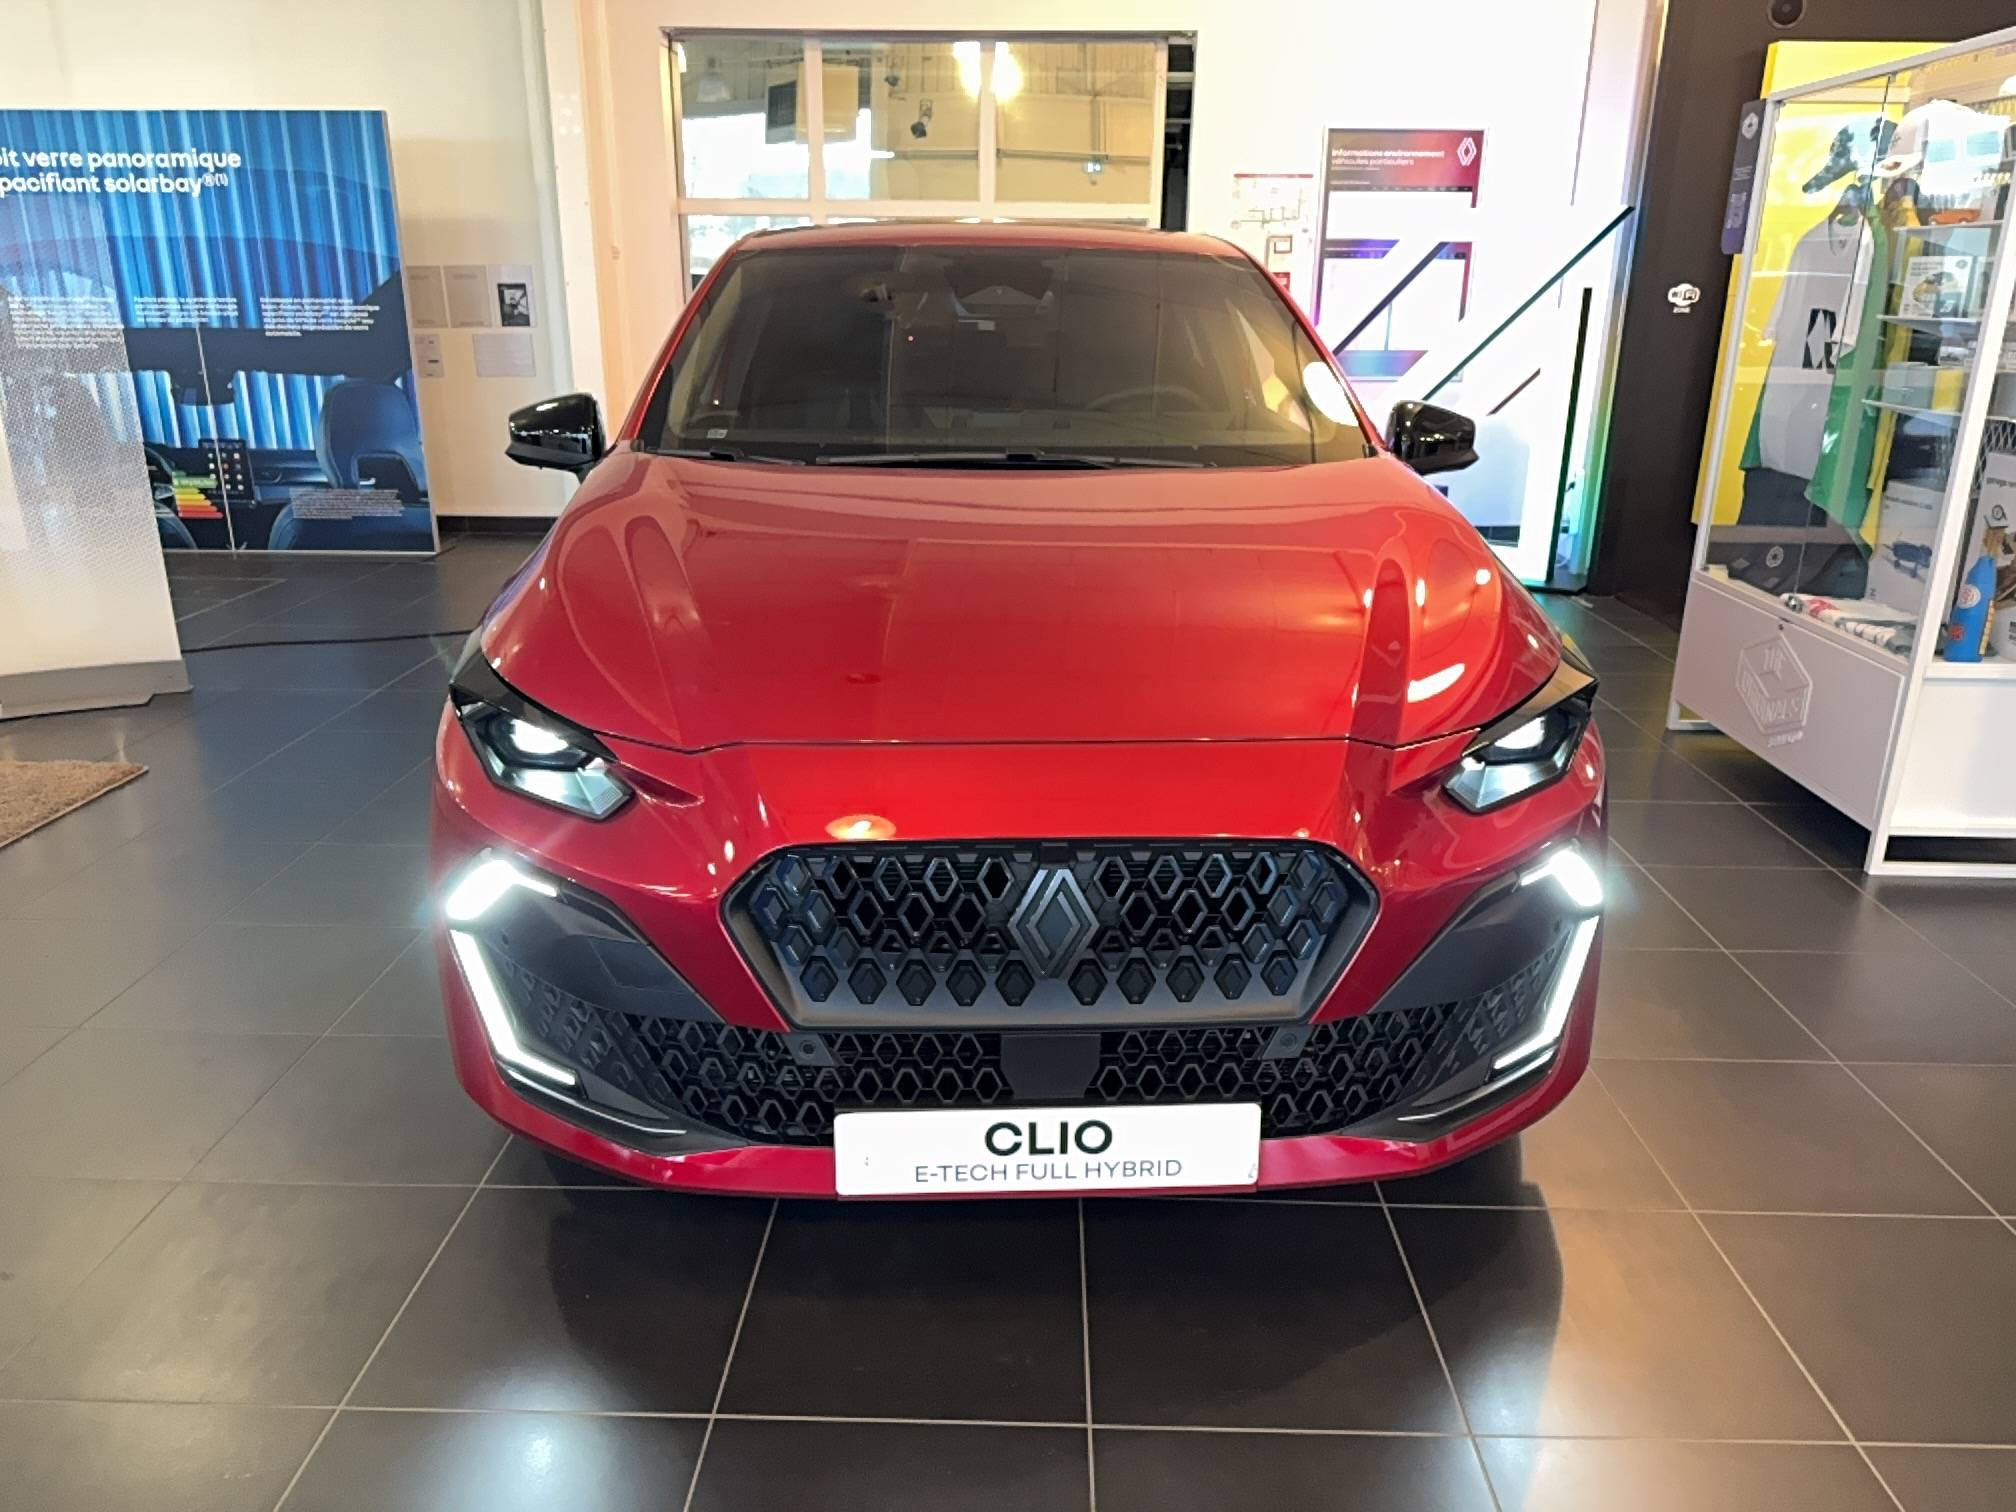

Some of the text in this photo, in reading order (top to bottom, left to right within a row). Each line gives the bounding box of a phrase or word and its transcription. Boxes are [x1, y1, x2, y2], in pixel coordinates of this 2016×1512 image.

[0, 147, 242, 173] it verre panoramique
[0, 172, 101, 199] pacifiant
[984, 1119, 1113, 1157] CLIO
[915, 1159, 1182, 1183] E-TECH FULL HYBRID
